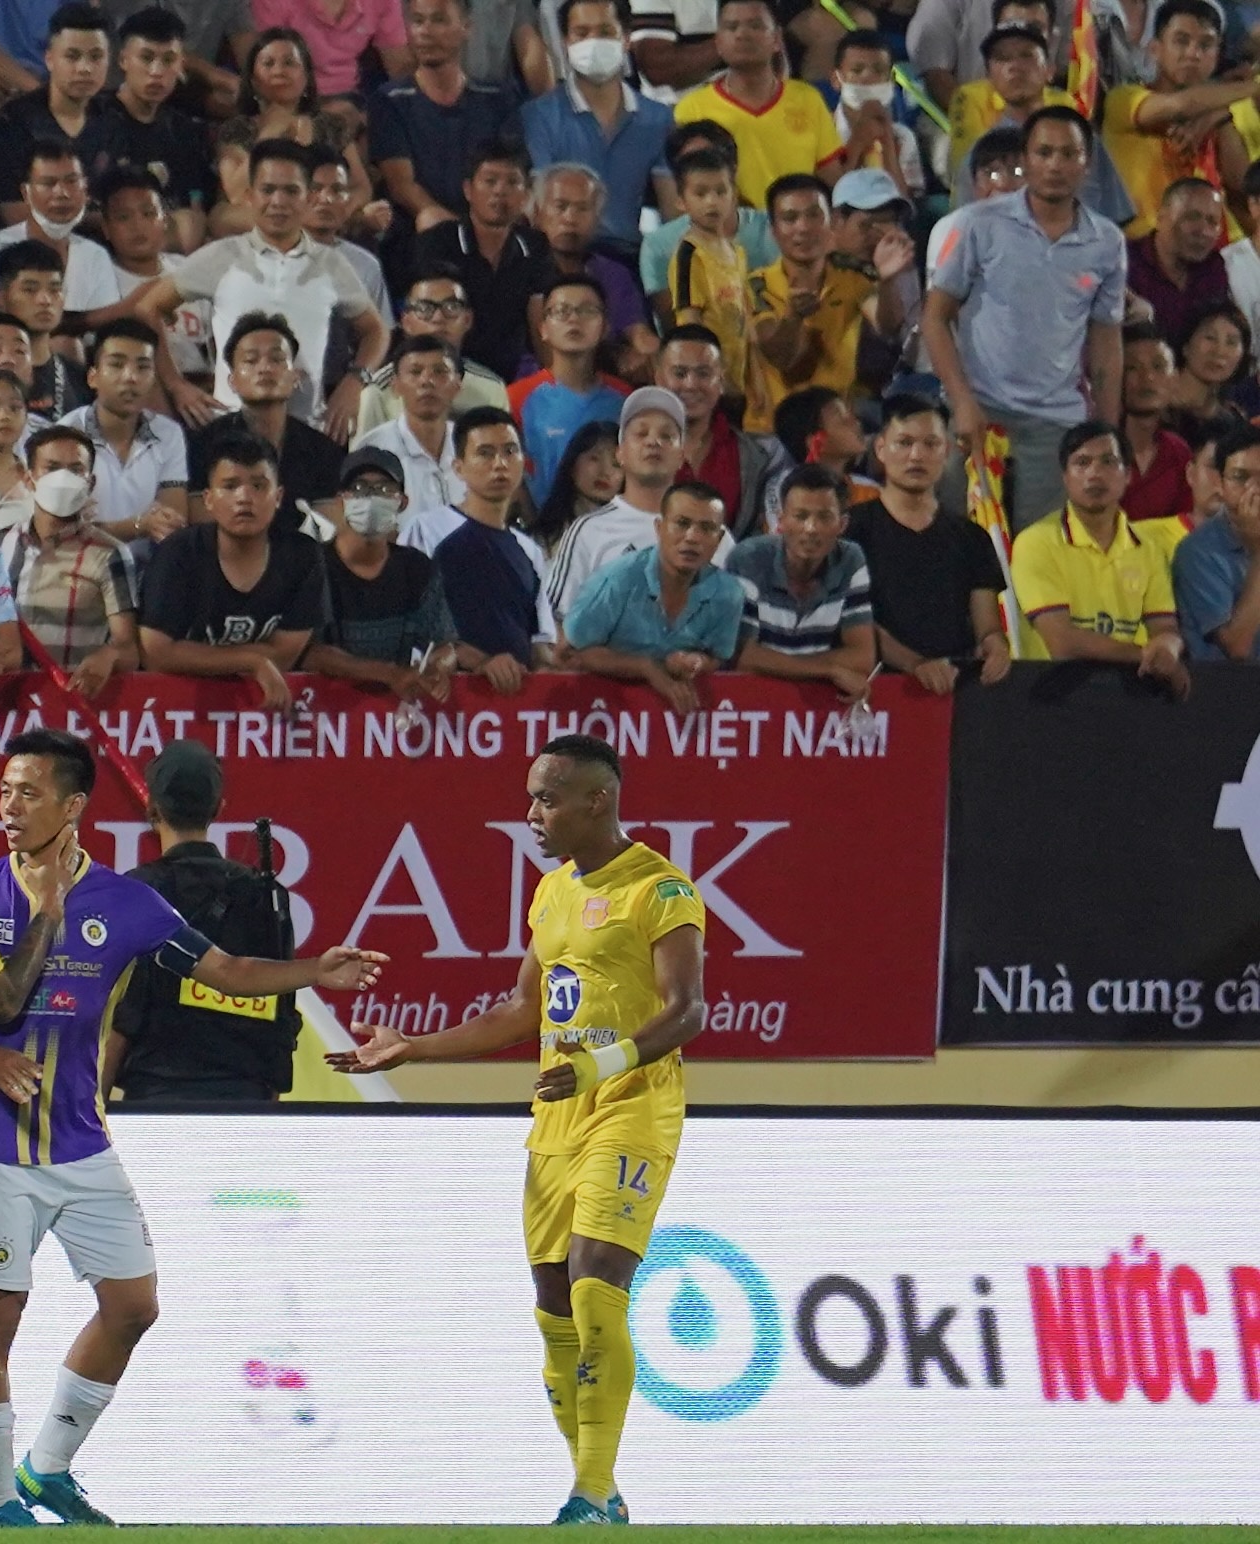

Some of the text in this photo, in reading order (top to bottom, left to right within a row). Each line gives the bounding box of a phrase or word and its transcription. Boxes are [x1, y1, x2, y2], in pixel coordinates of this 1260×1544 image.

[207, 687, 347, 758] TRIỂN
[363, 698, 502, 758] NÔNG
[517, 699, 649, 758] THÔN
[664, 699, 770, 770] VIỆT
[783, 710, 889, 758] NAM
[973, 963, 1074, 1014] Nhà
[1087, 979, 1204, 1029] cung
[618, 1155, 649, 1198] 14
[795, 1274, 1006, 1389] Oki
[1026, 1233, 1218, 1404] NƯỚC
